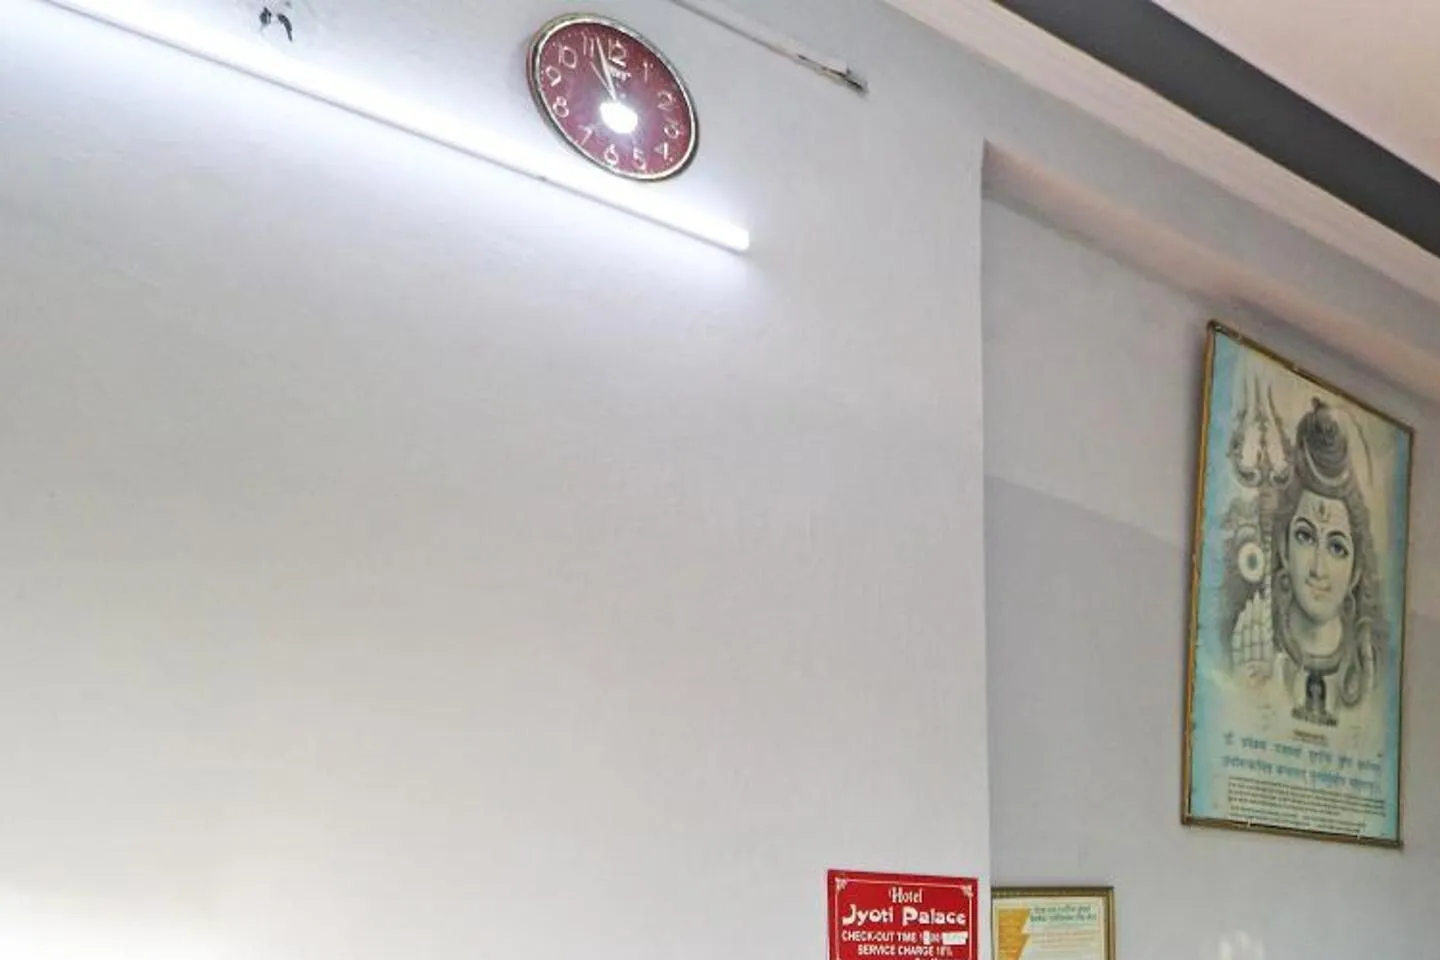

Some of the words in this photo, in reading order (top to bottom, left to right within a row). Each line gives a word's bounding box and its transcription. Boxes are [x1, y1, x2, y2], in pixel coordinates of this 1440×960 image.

[608, 38, 628, 67] 12
[545, 65, 562, 87] 9
[552, 95, 570, 118] 8
[657, 90, 675, 111] 2
[578, 124, 595, 145] 7
[603, 143, 619, 165] 6
[632, 147, 647, 171] 5
[653, 141, 669, 161] 4
[889, 886, 923, 904] Hotel
[842, 904, 894, 927] Jyoti
[902, 906, 967, 927] Palace
[857, 944, 896, 956] SERVICE
[898, 945, 935, 957] CHARGE
